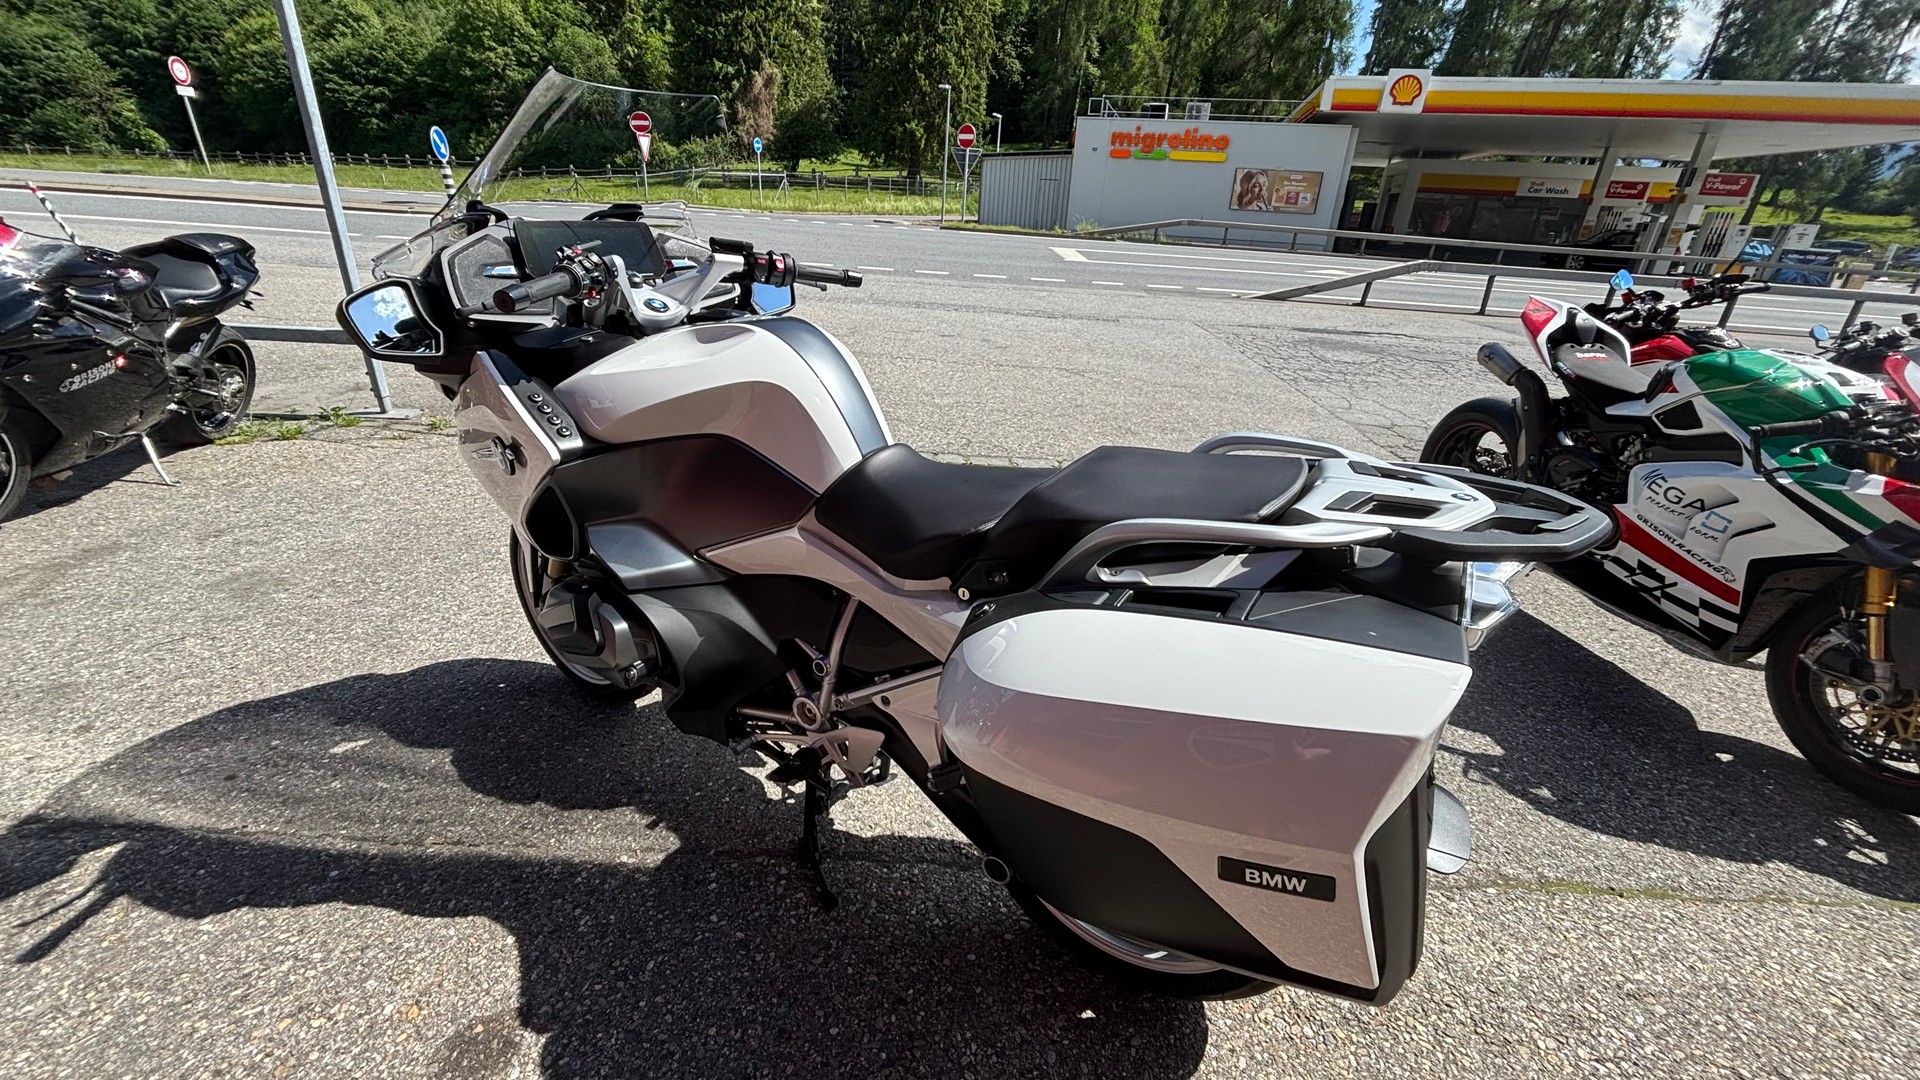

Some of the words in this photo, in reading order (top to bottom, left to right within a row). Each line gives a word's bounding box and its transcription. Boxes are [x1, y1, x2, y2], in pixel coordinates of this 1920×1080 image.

[1110, 125, 1230, 154] migrolino
[1528, 186, 1542, 194] Car
[1545, 187, 1569, 195] Wash
[1609, 187, 1640, 195] V-Power
[1705, 182, 1742, 191] V-Power
[70, 367, 116, 391] RACING
[74, 359, 117, 383] GRISONI
[1640, 468, 1706, 512] MEGA
[1244, 867, 1307, 893] BMW
